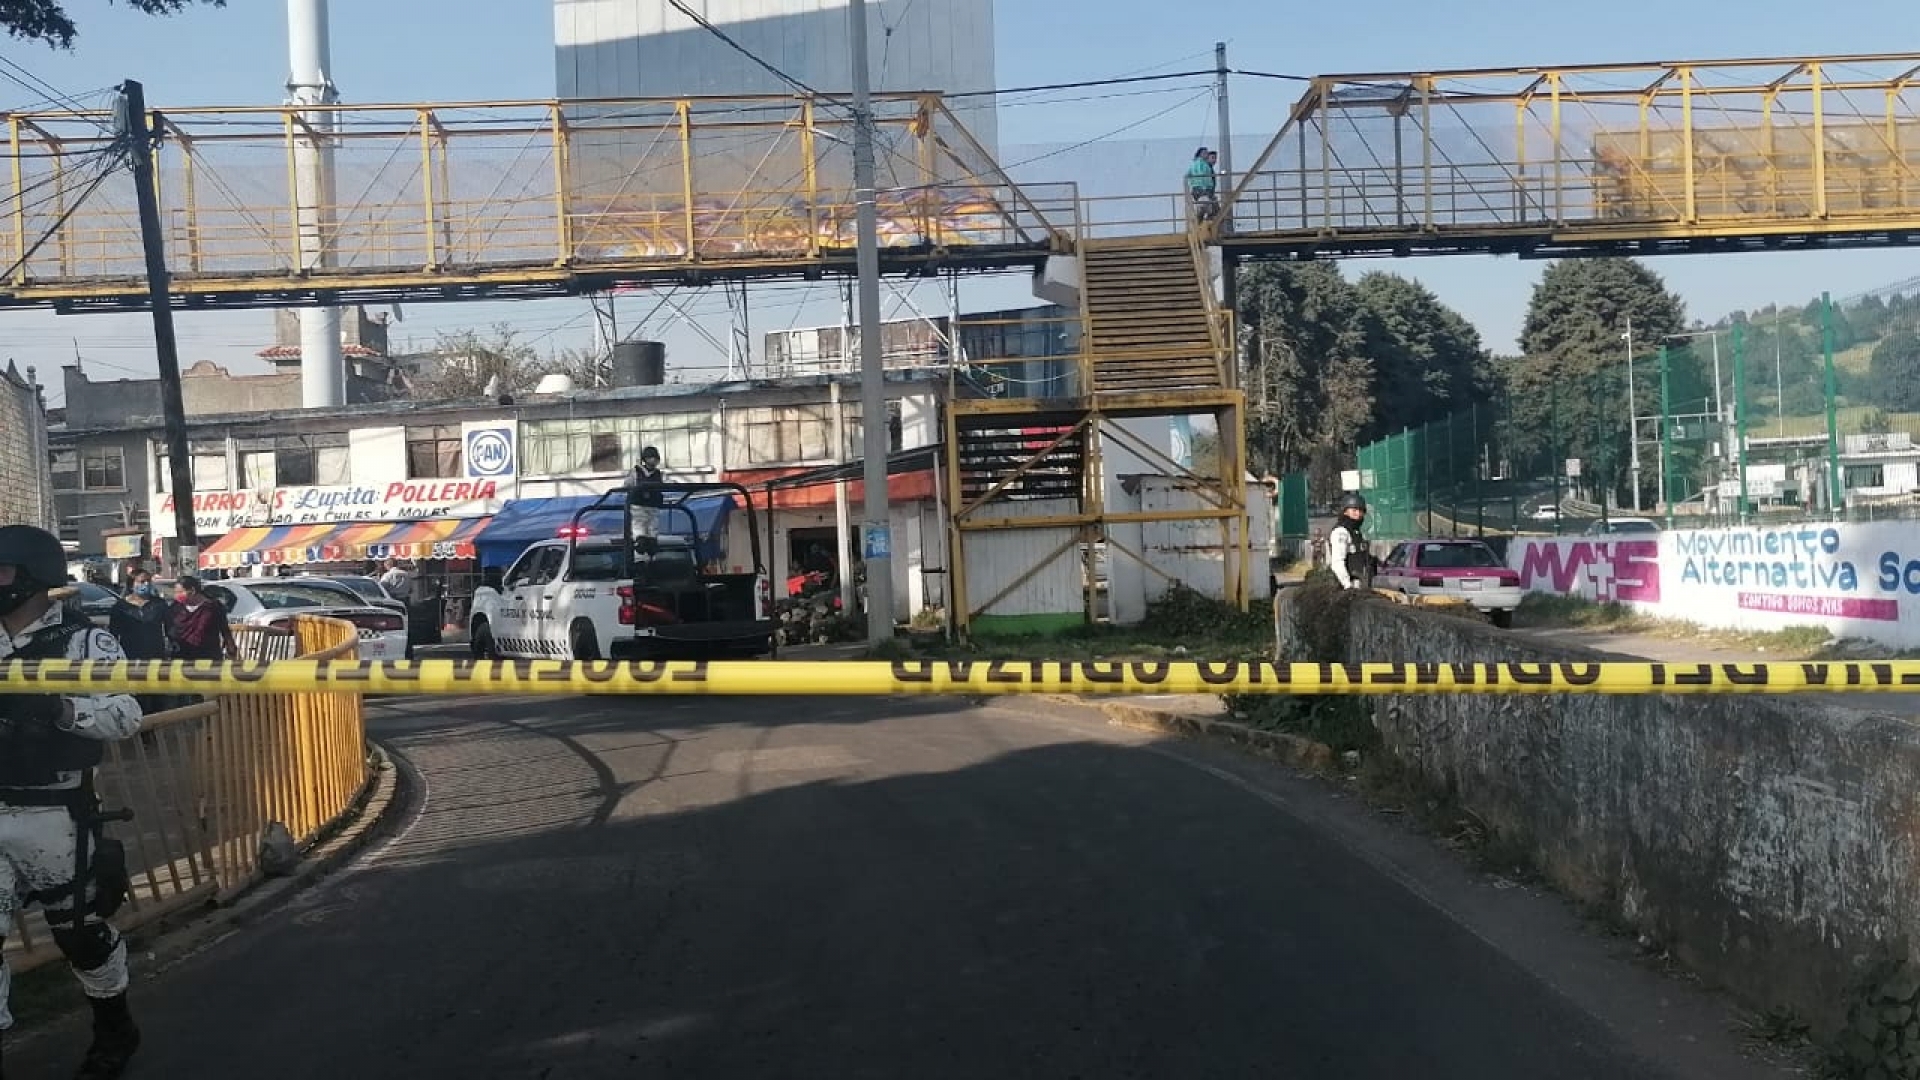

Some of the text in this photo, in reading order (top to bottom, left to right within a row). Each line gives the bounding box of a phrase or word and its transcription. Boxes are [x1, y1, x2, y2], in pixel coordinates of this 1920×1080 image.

[294, 488, 376, 510] Lupita
[383, 477, 497, 504] POLLERÍA
[193, 516, 222, 529] RAN
[398, 506, 451, 519] MOLES
[1676, 526, 1841, 556] Movimiento
[1681, 550, 1859, 591] Alternativa
